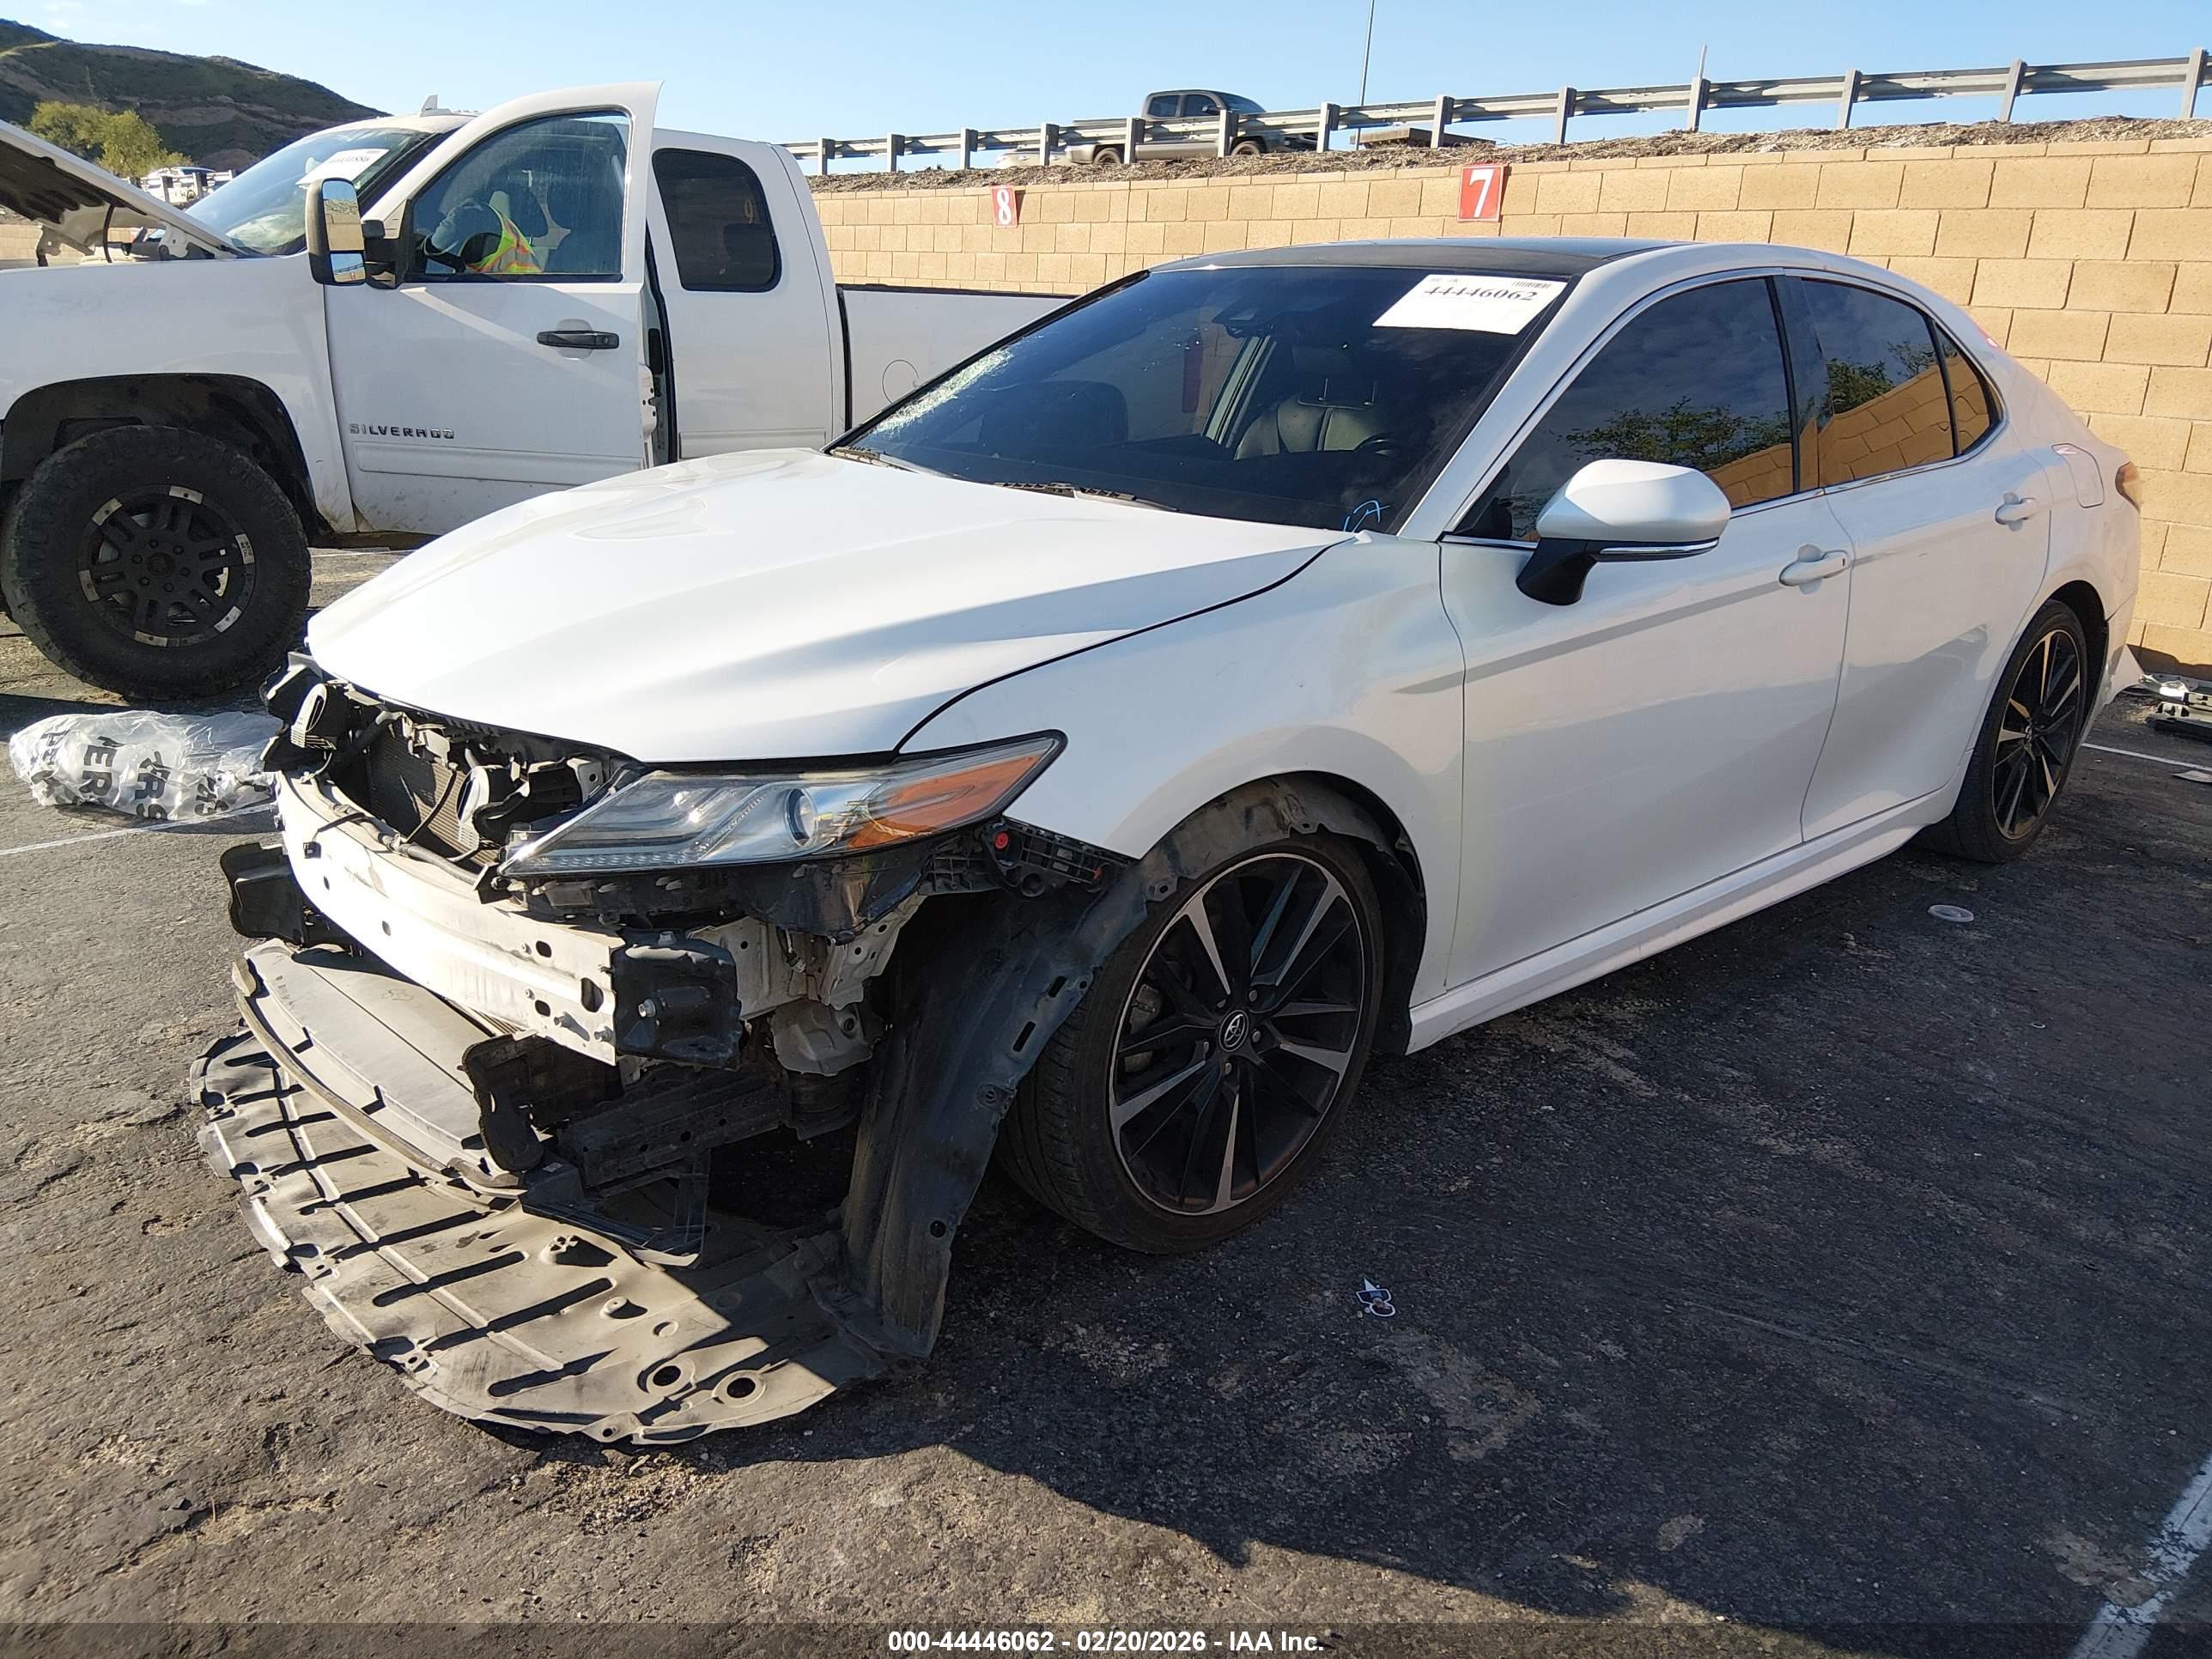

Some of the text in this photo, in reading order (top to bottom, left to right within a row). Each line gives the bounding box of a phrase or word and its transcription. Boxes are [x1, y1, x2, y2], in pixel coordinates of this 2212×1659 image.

[1469, 168, 1494, 218] 7
[996, 189, 1012, 225] 8
[1424, 285, 1538, 301] 44446062
[349, 423, 455, 440] SILVERADO
